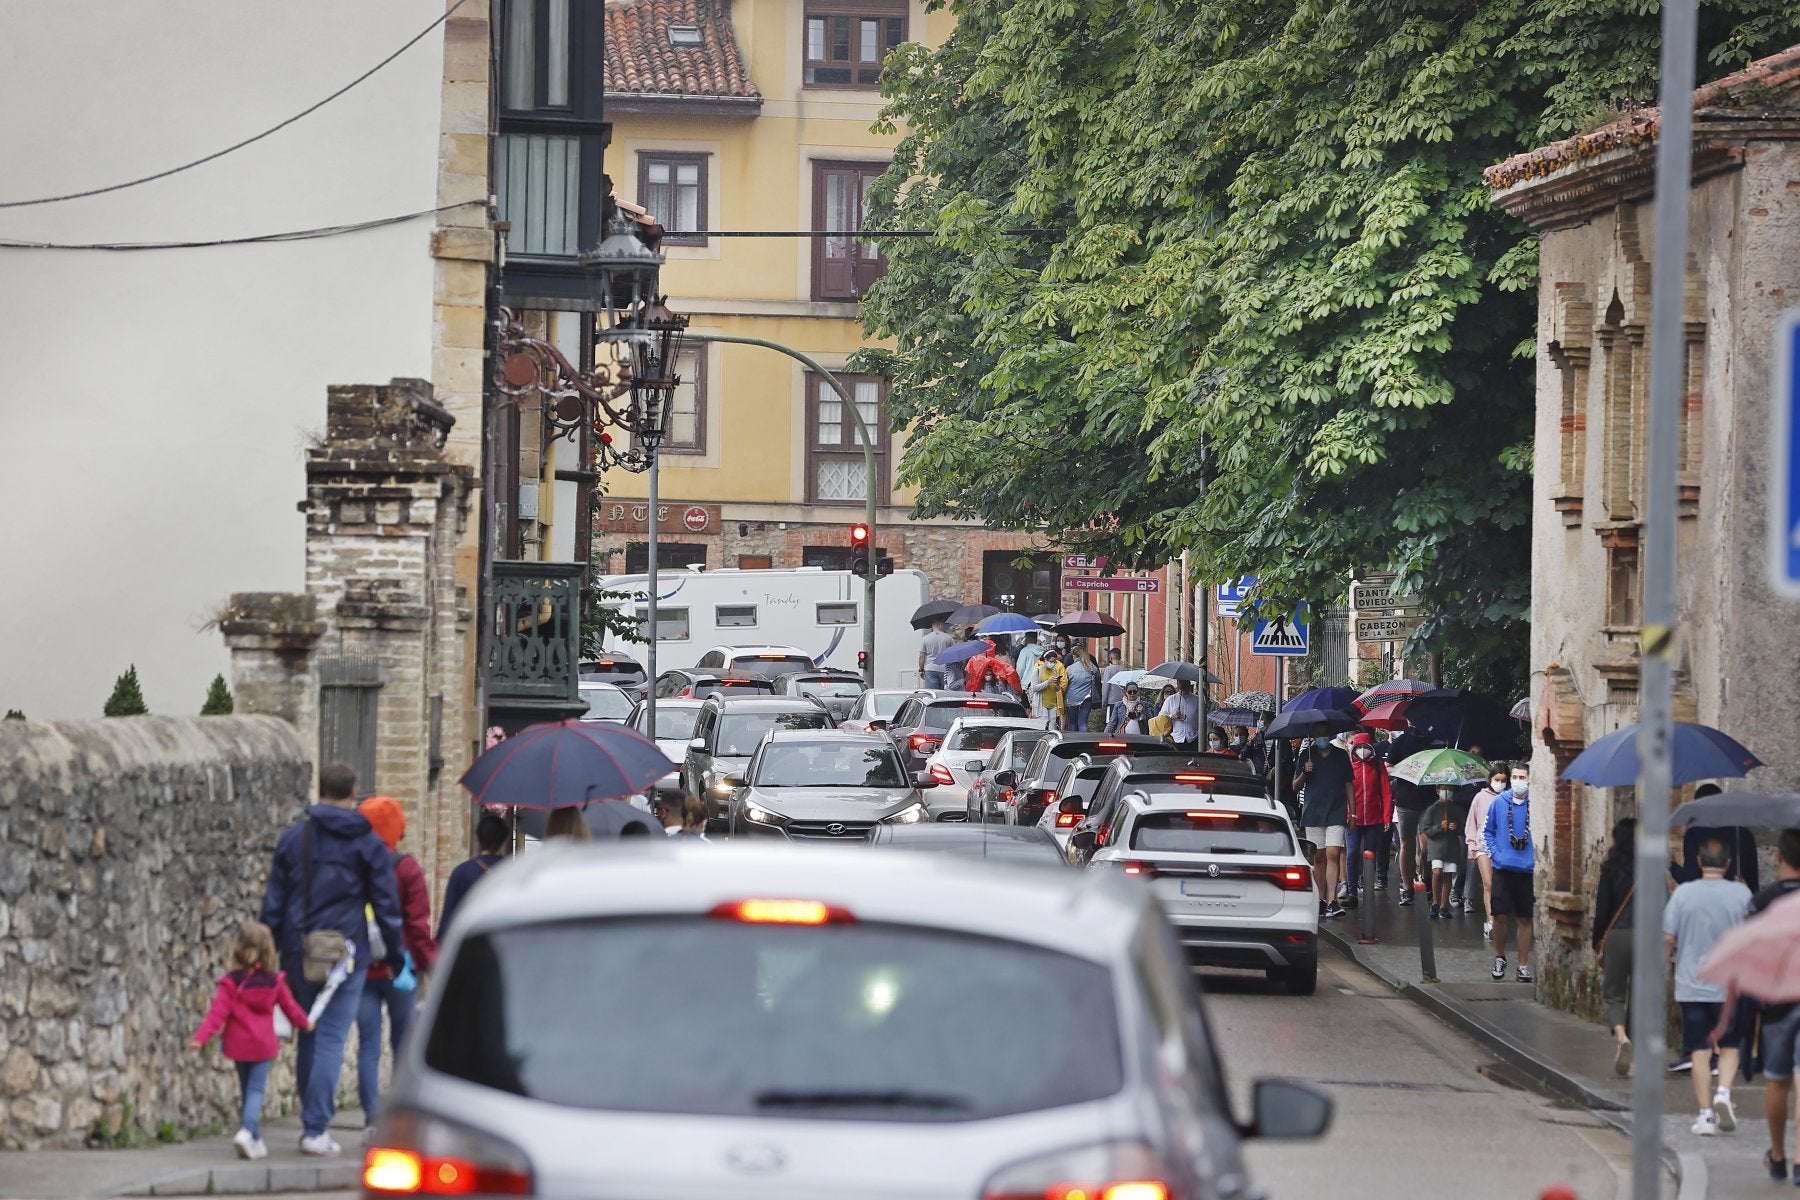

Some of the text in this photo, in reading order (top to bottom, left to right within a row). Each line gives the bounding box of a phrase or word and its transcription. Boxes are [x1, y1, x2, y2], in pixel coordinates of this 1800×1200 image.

[764, 592, 800, 608] Tandy
[1358, 598, 1395, 606] OVIEDO
[1360, 620, 1406, 630] CABEZÓN
